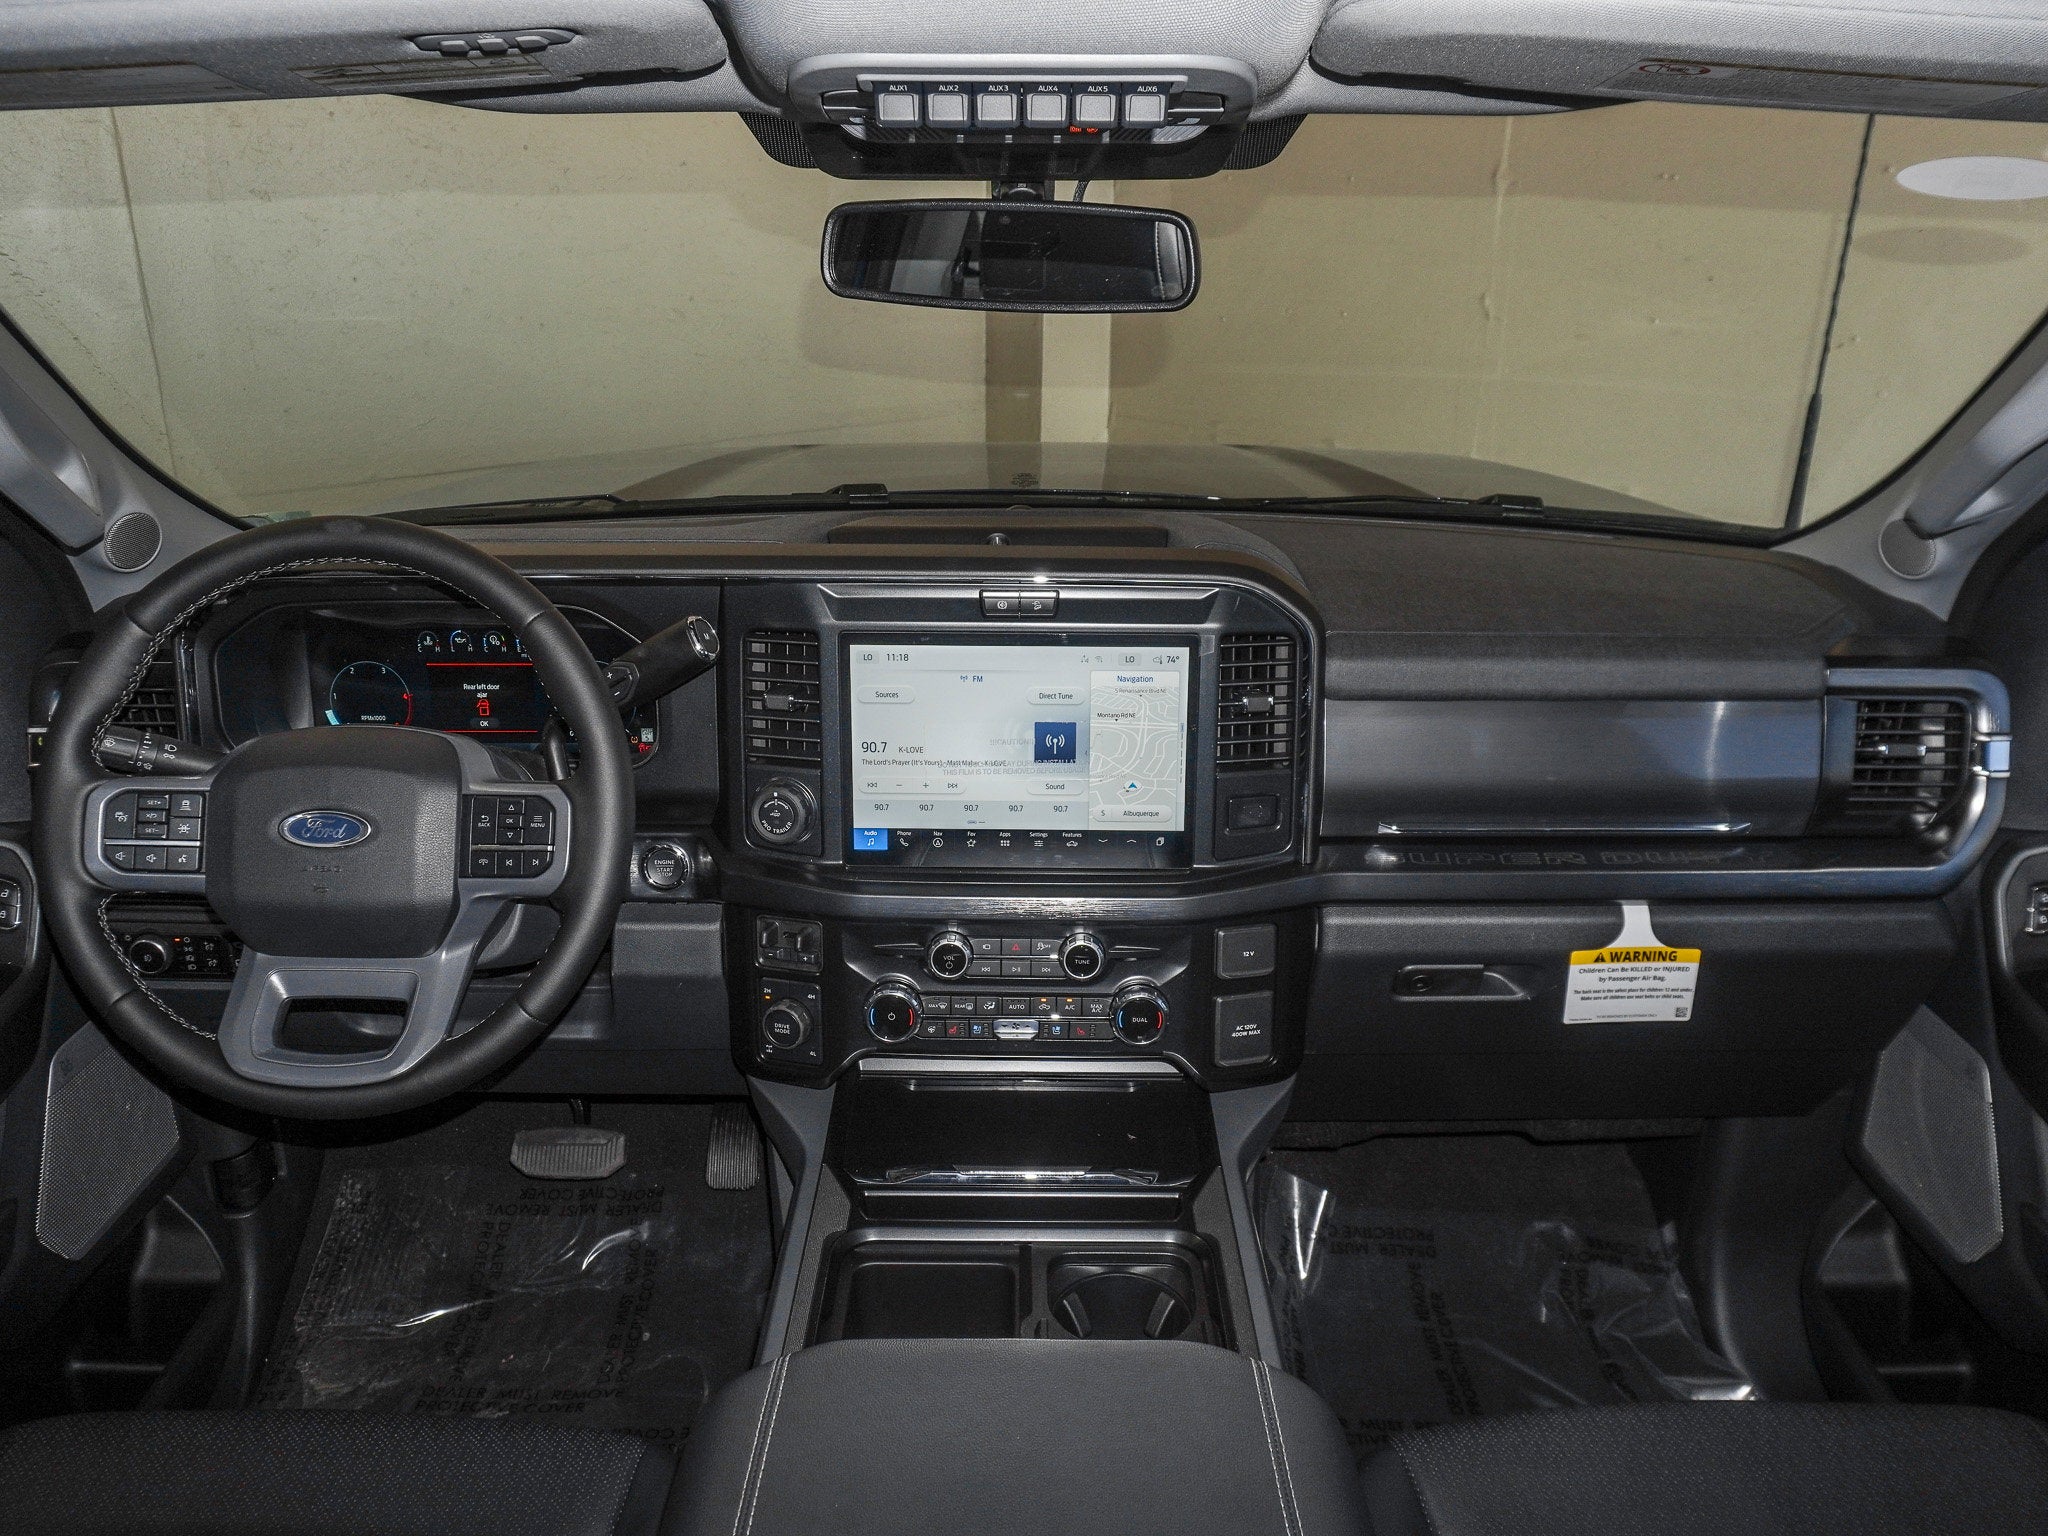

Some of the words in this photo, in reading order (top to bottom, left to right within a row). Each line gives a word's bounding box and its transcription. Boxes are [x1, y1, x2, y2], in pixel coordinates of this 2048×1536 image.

[886, 654, 909, 662] 11:18
[1117, 675, 1154, 684] Navigation
[861, 742, 888, 753] 90.7
[892, 760, 910, 768] Prayer
[964, 804, 979, 812] 90.7
[1123, 810, 1160, 818] Albuquerque
[301, 817, 346, 841] Ford
[1610, 951, 1678, 962] WARNING
